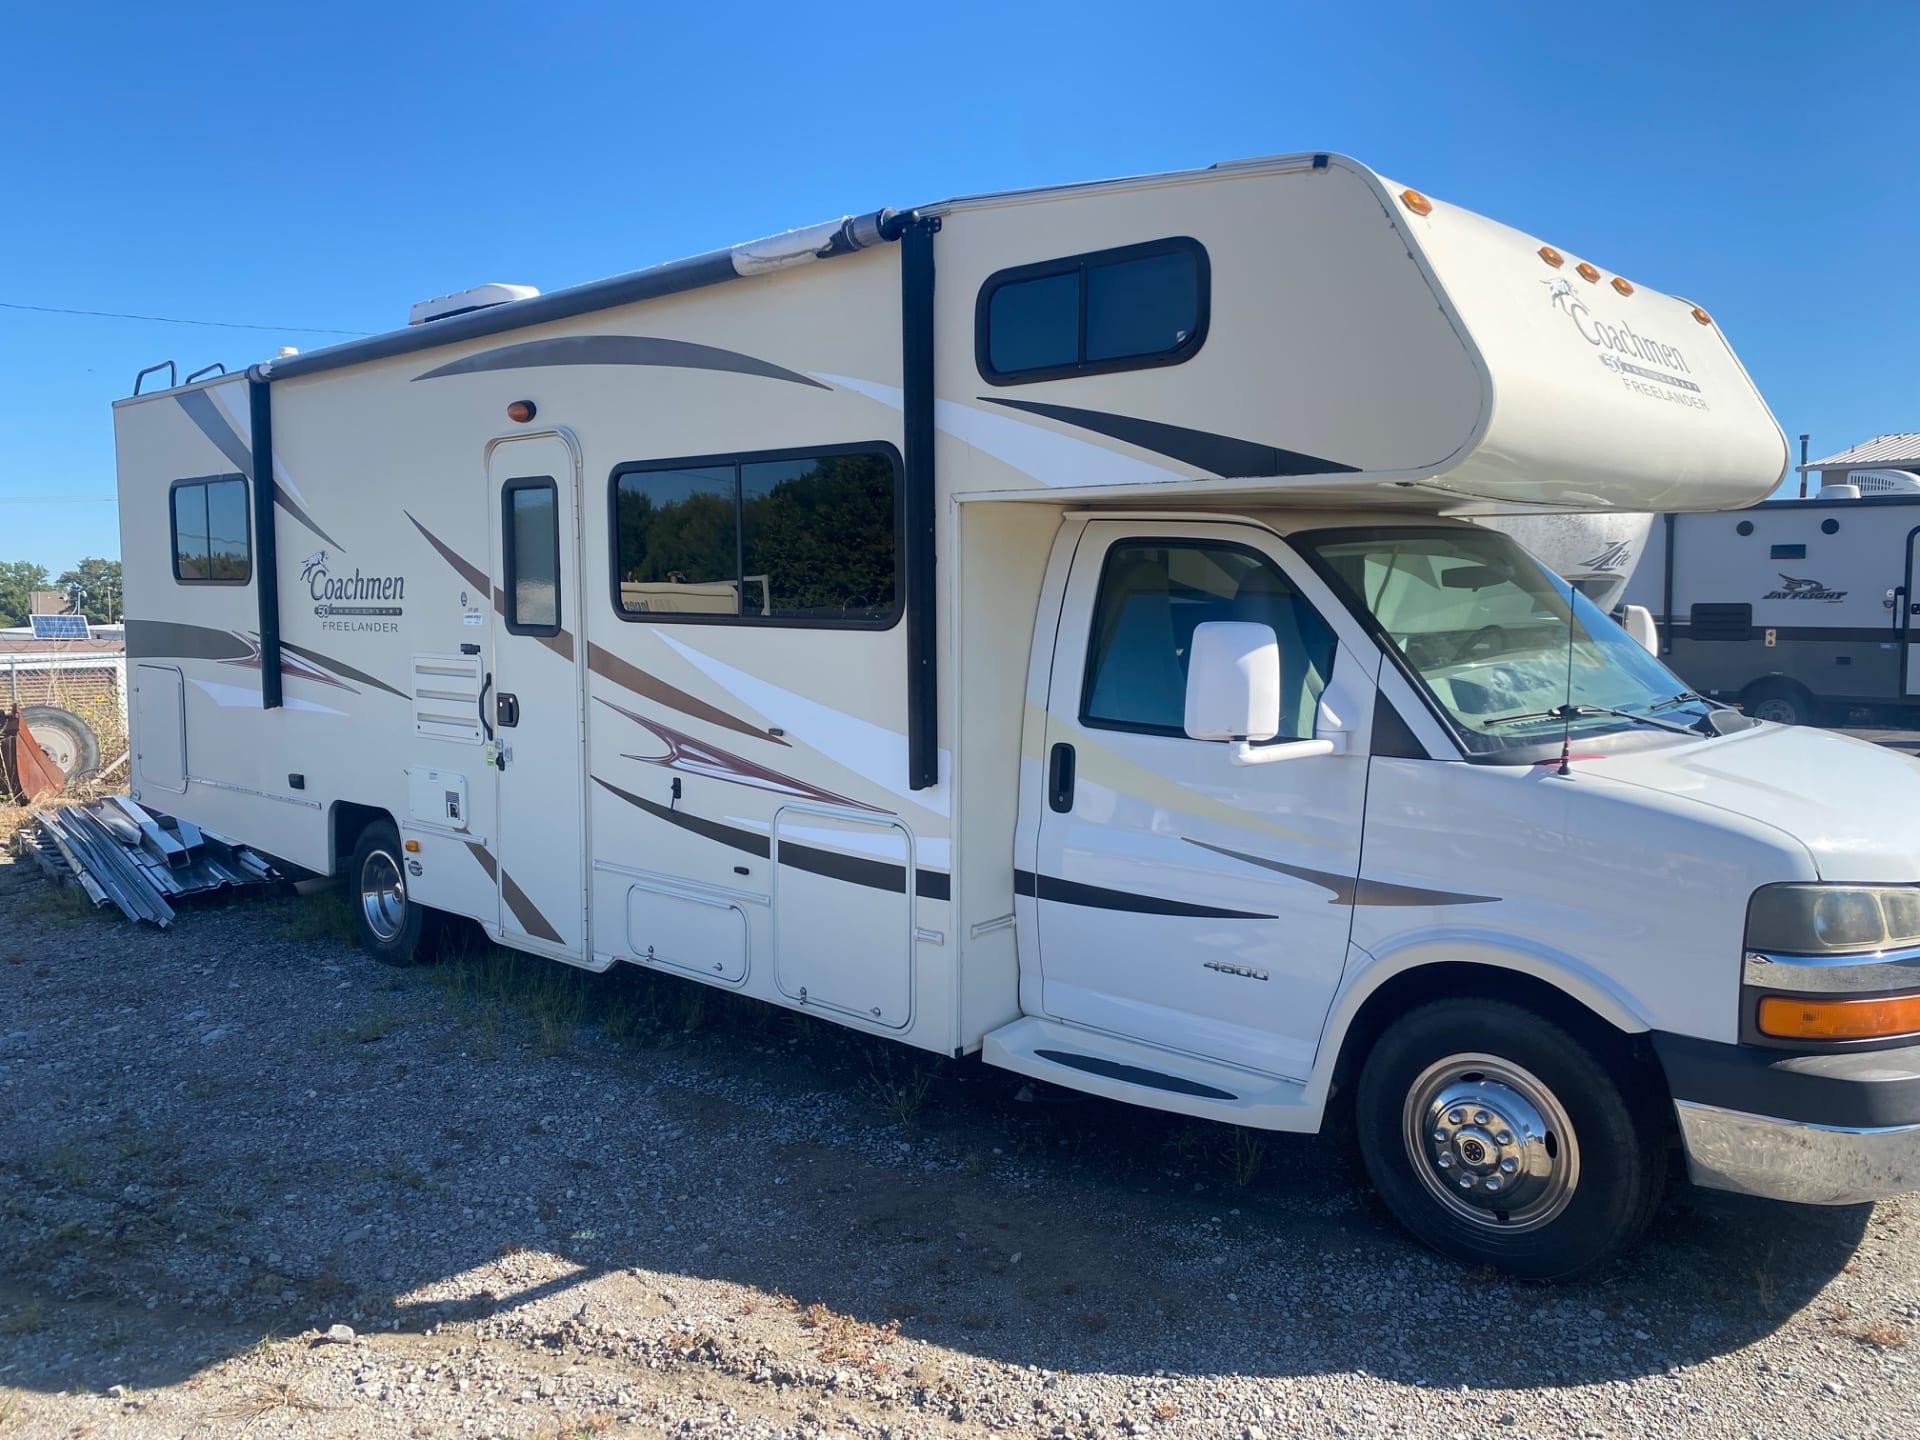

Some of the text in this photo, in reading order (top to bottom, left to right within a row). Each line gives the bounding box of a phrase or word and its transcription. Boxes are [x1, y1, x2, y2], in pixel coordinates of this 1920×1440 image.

[1571, 303, 1692, 374] Coachmen
[1622, 377, 1709, 411] FREELANDER
[310, 568, 404, 601] Coachmen
[1761, 590, 1848, 600] JAY FLIGHT
[322, 621, 399, 633] FREELANDER
